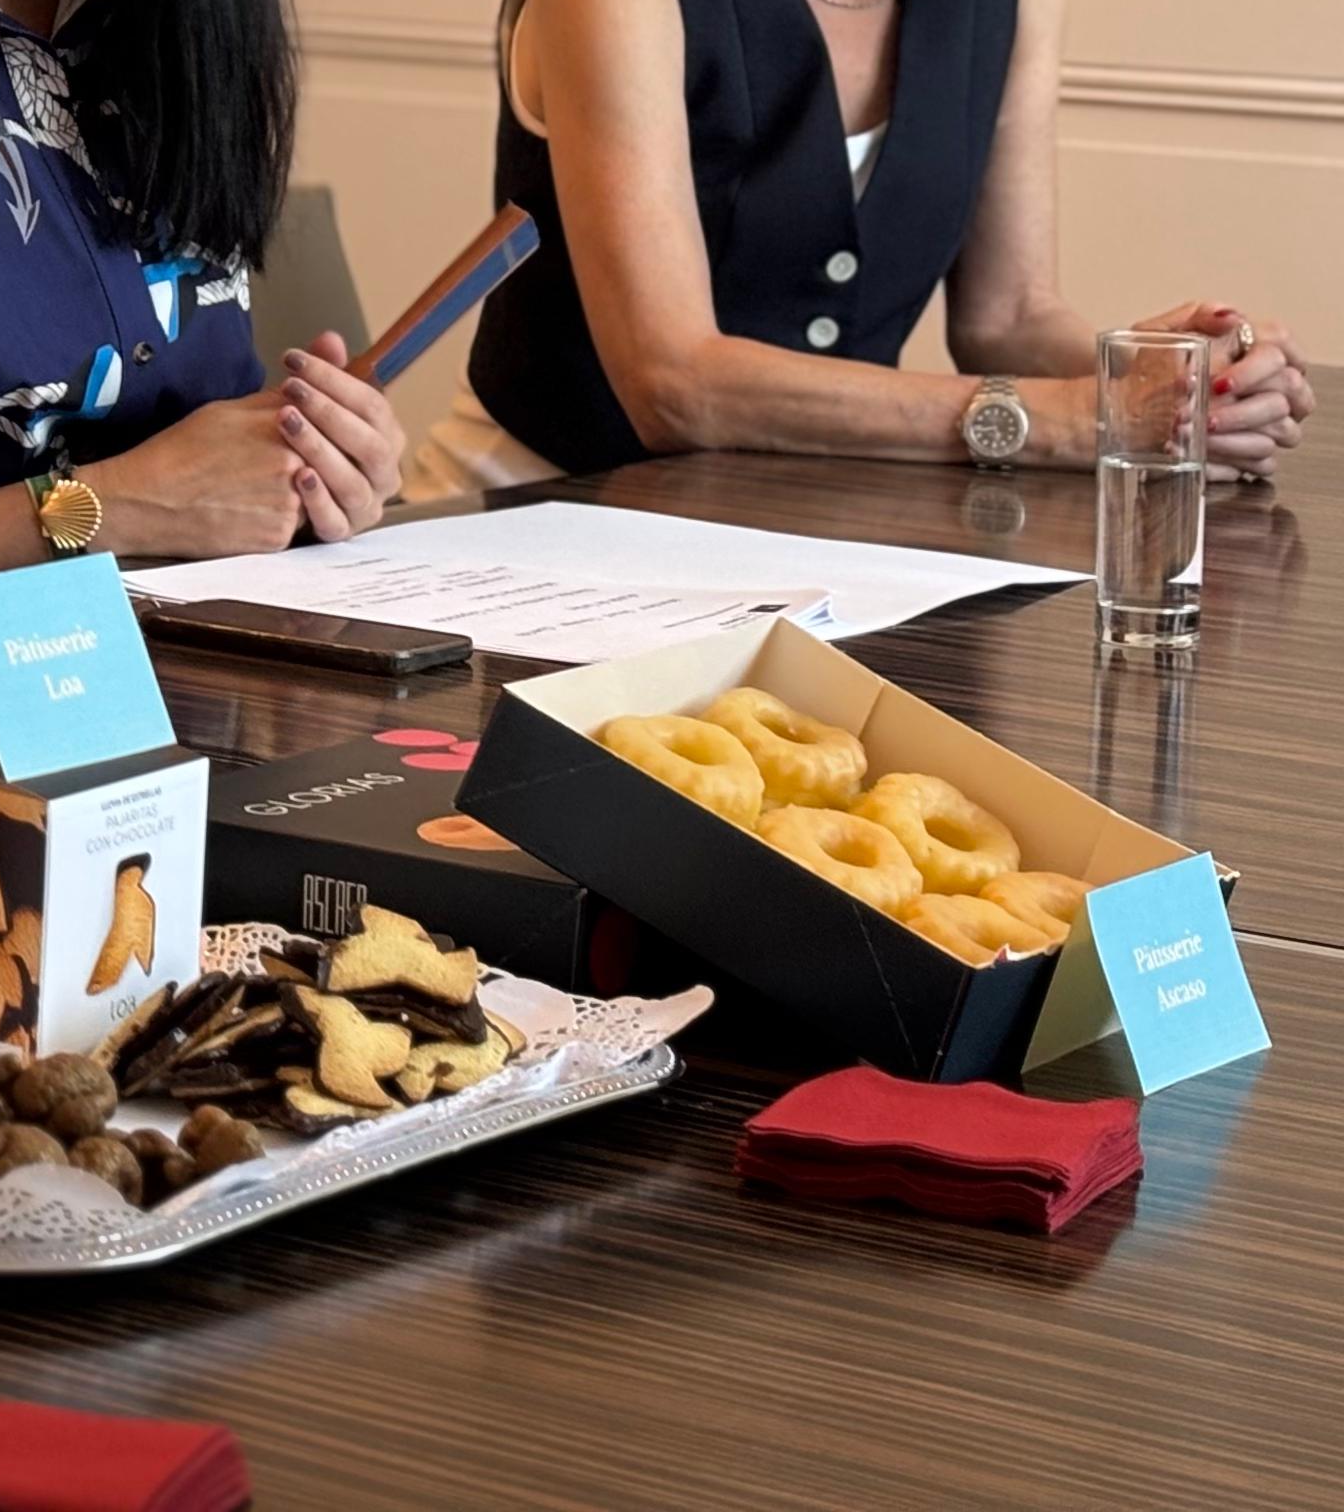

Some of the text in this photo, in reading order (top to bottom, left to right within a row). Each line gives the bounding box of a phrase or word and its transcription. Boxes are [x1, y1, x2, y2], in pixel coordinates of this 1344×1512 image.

[3, 624, 97, 666] Pâtisserie
[43, 673, 86, 701] Loa
[244, 772, 405, 816] GLORIAS
[1133, 928, 1204, 974] Pâtisserie
[1156, 978, 1207, 1013] Ascaso
